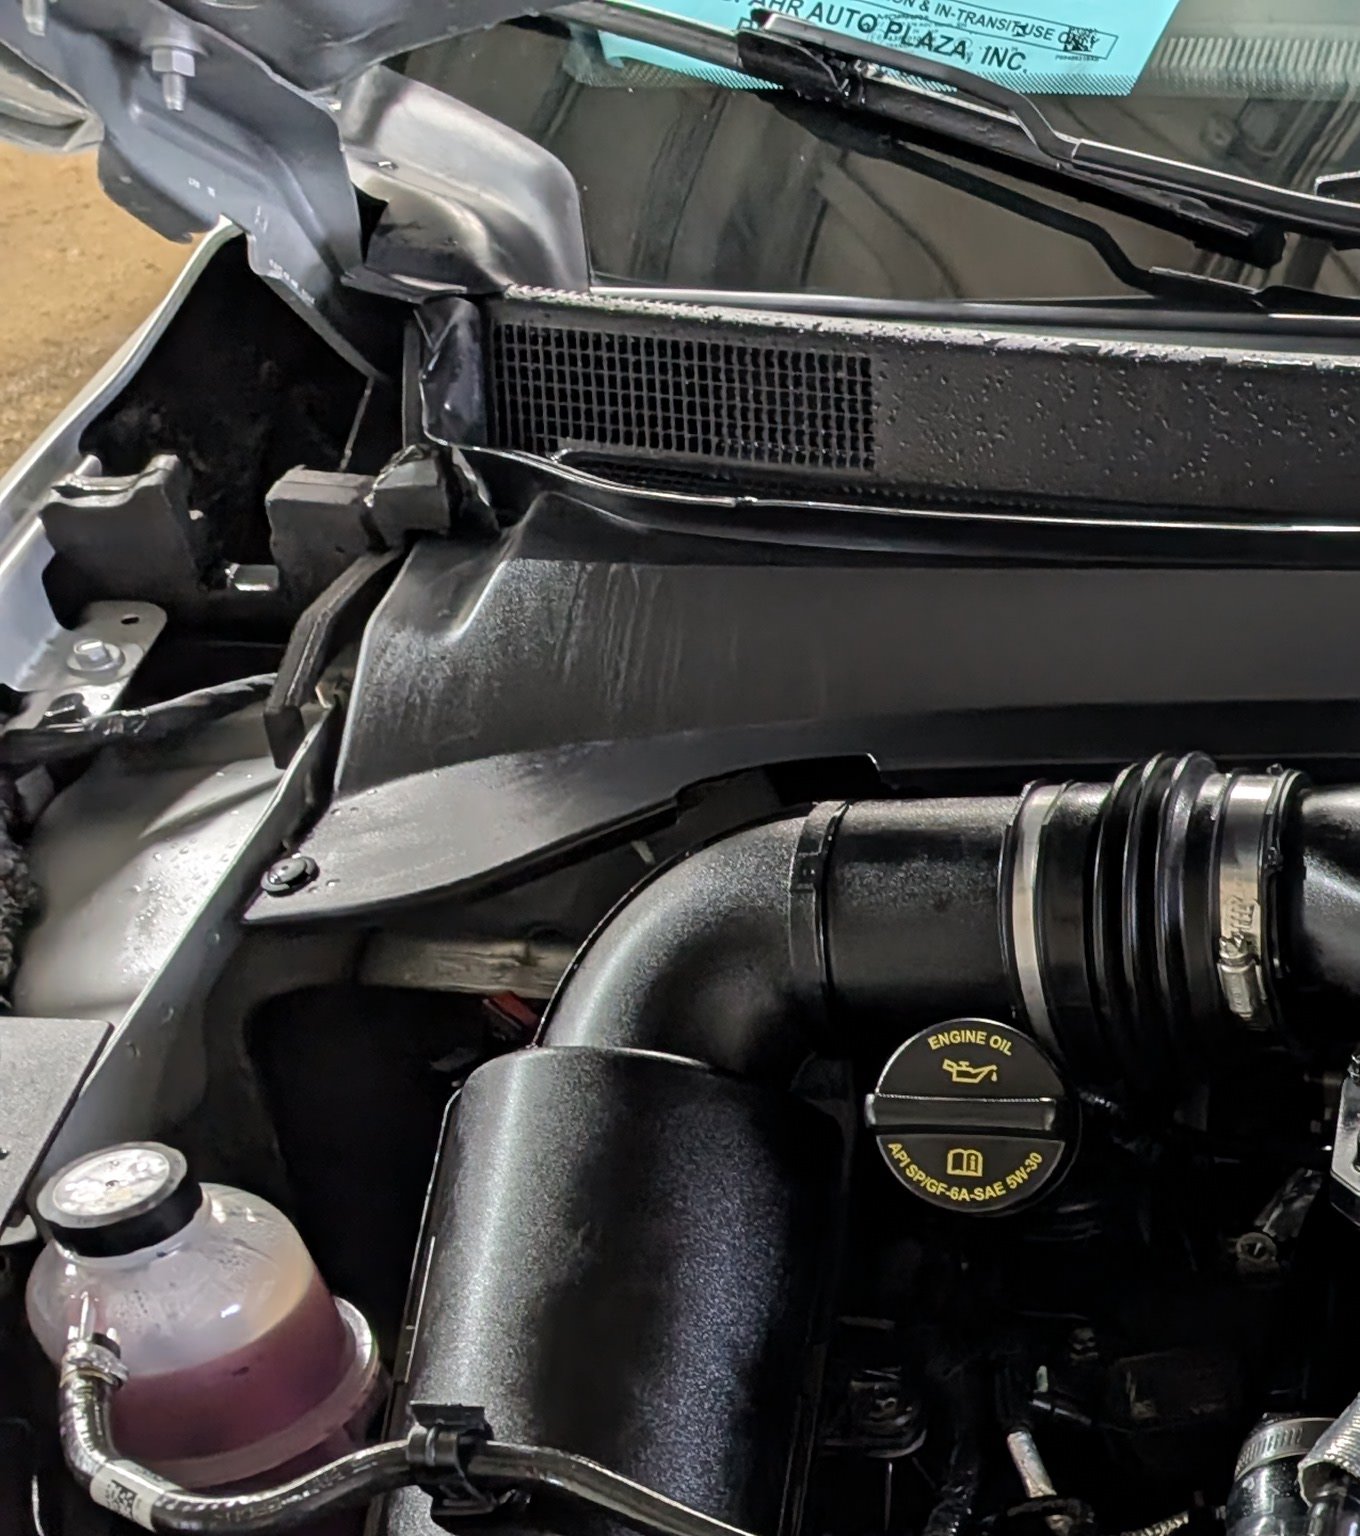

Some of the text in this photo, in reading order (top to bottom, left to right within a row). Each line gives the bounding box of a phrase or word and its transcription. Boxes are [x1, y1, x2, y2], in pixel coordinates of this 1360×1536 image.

[805, 4, 878, 34] AUTO
[980, 45, 1028, 74] INC.
[927, 1030, 1013, 1056] ENGINE OIL
[887, 1142, 911, 1168] API
[1006, 1152, 1043, 1190] 5W-30
